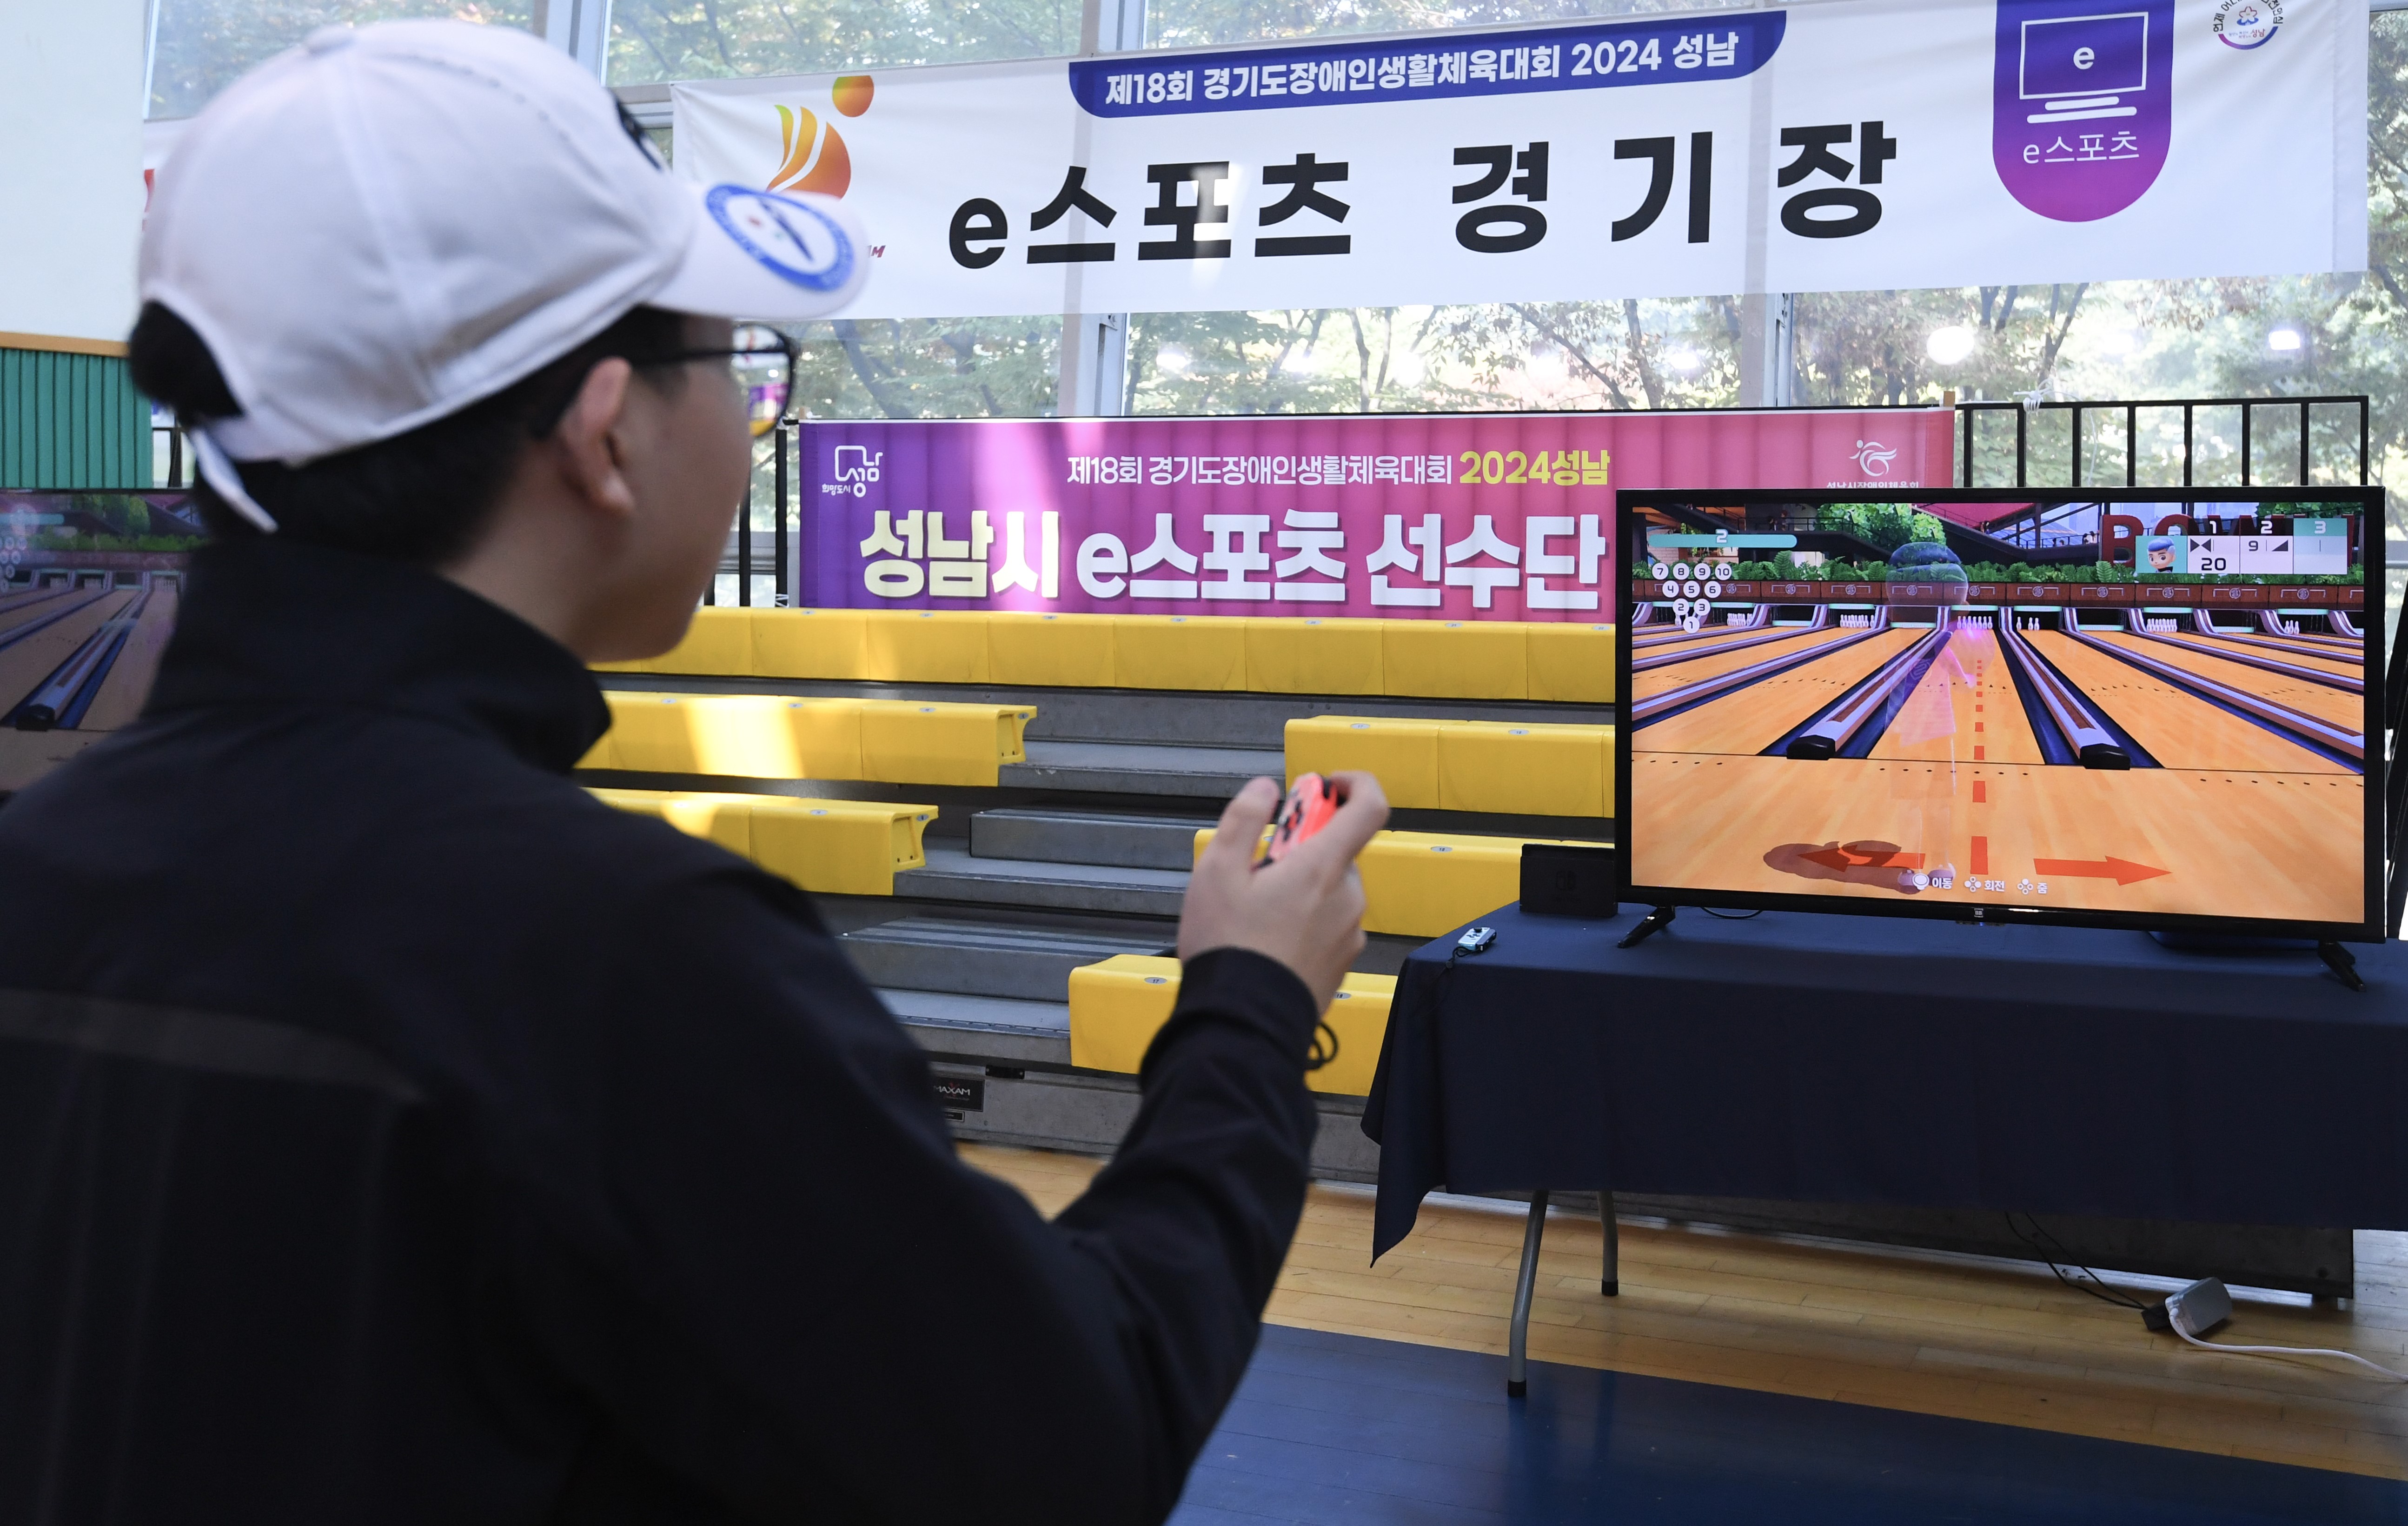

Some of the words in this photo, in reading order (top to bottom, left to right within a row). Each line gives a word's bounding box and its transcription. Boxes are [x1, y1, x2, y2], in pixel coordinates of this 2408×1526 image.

[2073, 47, 2095, 69] e
[1106, 70, 1193, 105] 제18회
[1203, 46, 1560, 100] 경기도장애인생활체육대회
[1571, 38, 1662, 76] 2024
[1672, 32, 1739, 69] 성남
[2023, 131, 2140, 164] e스포츠
[949, 153, 1351, 269] e스포츠
[1067, 456, 1142, 484] 제18회
[1149, 454, 1452, 485] 경기도장애인생활체육대회
[822, 483, 851, 496] 희망도시
[2209, 520, 2216, 534] 1
[2261, 520, 2273, 534] 2
[2314, 520, 2326, 534] 3
[1716, 529, 1728, 543] 2
[2249, 540, 2258, 551] 9
[860, 510, 1059, 599] 성남시
[1076, 508, 1346, 601] e스포츠
[1366, 513, 1606, 609] 선수단
[2202, 558, 2226, 571] 20
[1718, 568, 1730, 576] 10
[1932, 877, 1953, 889] 이동
[1984, 880, 2005, 892] 회전
[2037, 882, 2048, 894] 줌
[933, 1086, 970, 1095] MAXAM
